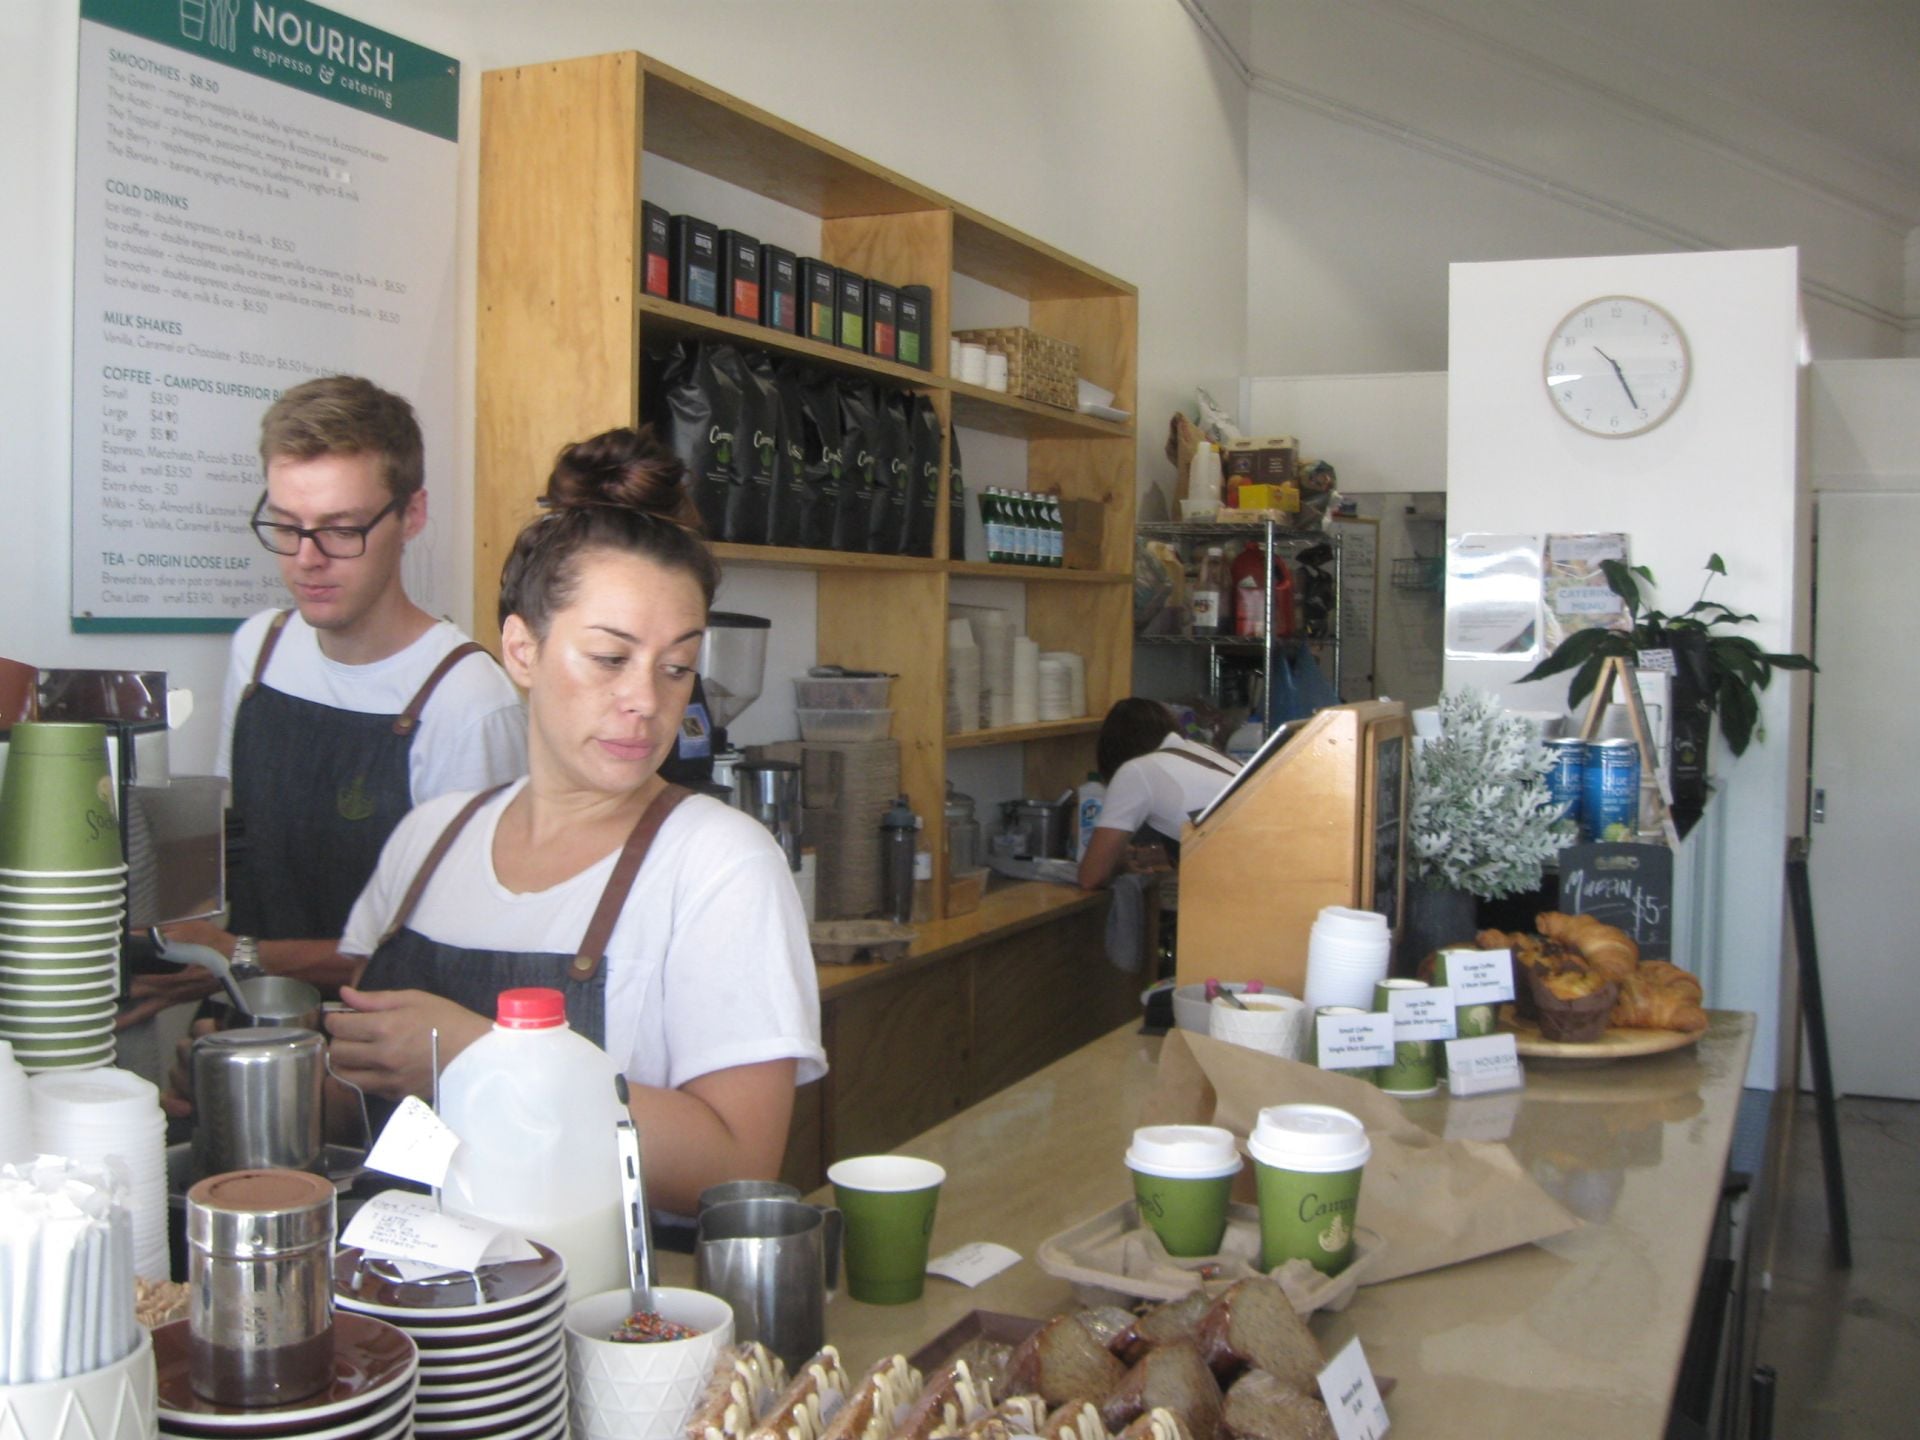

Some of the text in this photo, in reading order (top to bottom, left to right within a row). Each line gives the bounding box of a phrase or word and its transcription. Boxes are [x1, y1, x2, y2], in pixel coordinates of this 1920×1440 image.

[252, 1, 395, 82] NOURISH
[108, 48, 219, 95] SMOOTHIES $8.50
[252, 44, 393, 109] espresso & catering
[105, 180, 189, 211] COLD DRINKS
[103, 311, 182, 336] MILK SHAKES
[103, 366, 152, 385] COFFEE
[163, 375, 213, 393] CAMPOS
[215, 383, 270, 401] SUPERIOR
[1610, 416, 1619, 427] 6
[101, 553, 250, 570] TEA ORIGIN LOOSE LEAF
